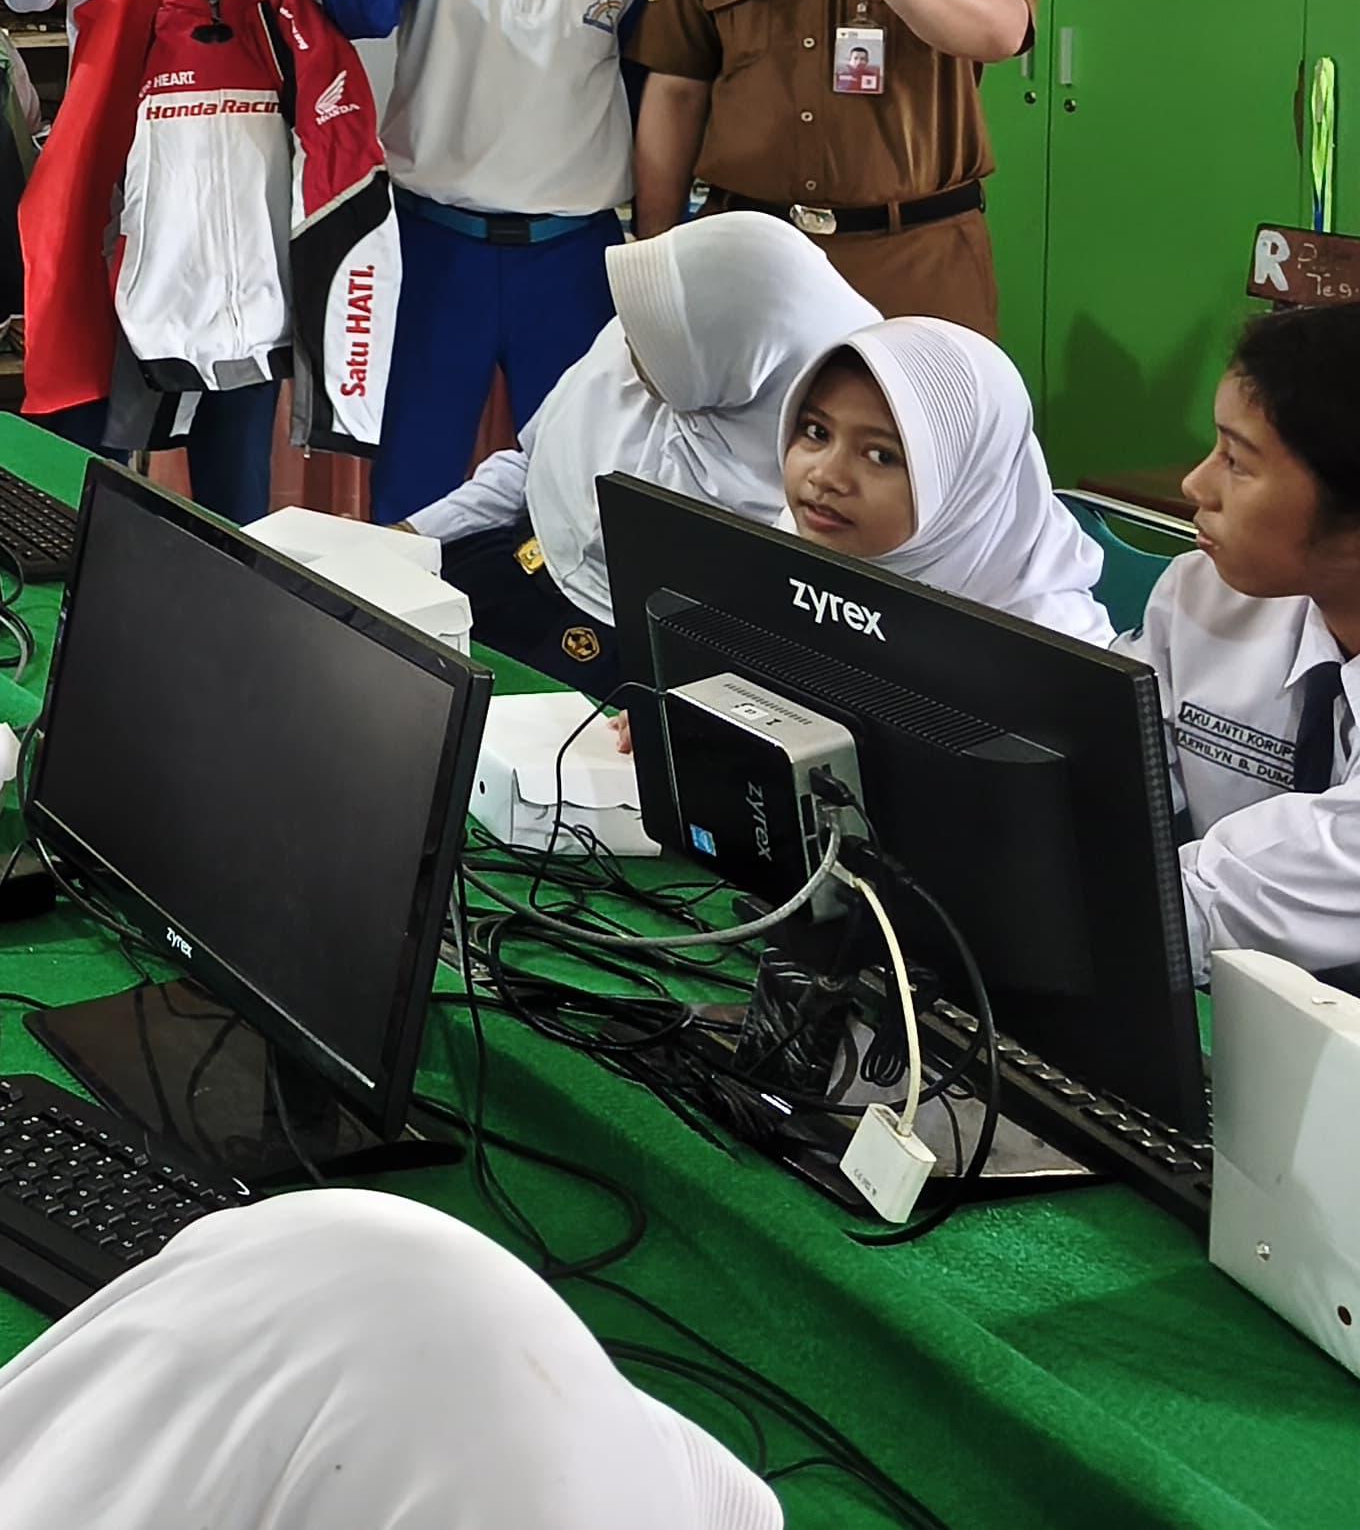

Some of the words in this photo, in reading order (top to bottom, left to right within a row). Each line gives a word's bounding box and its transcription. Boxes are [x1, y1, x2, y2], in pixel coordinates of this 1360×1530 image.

[146, 103, 217, 121] Honda
[220, 99, 281, 115] Racin
[345, 264, 375, 334] HATI.
[340, 341, 370, 397] Satu
[789, 577, 887, 642] zyrex
[1182, 708, 1211, 727] AKU
[1211, 720, 1244, 741] ANTI
[745, 780, 773, 862] zyrex
